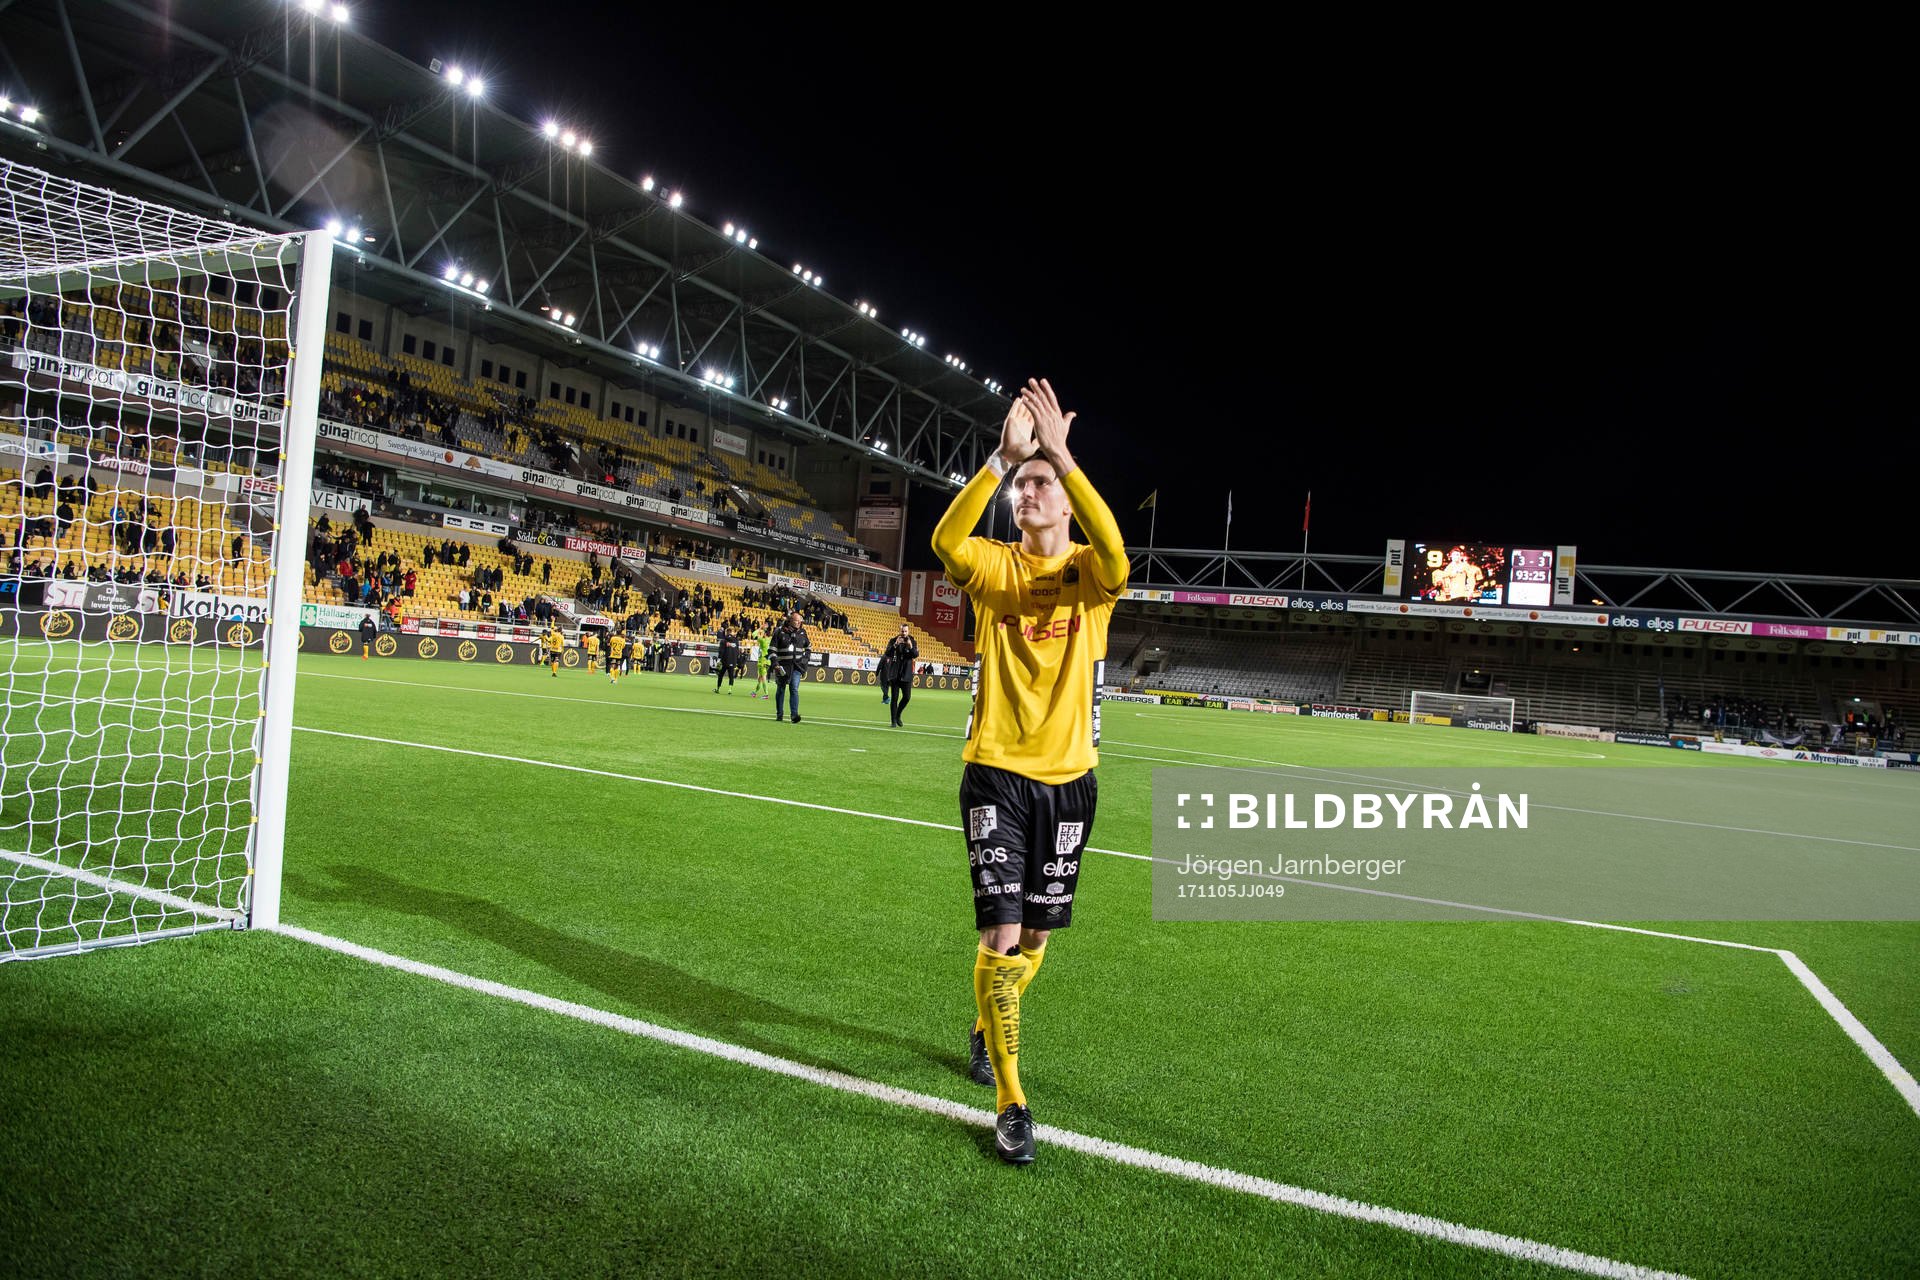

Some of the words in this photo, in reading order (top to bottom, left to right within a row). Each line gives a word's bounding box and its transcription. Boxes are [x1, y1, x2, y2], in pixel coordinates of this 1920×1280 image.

[234, 401, 281, 422] ginatri
[387, 440, 417, 453] Swedbank
[244, 479, 278, 492] SPEE
[309, 491, 361, 511] VENTI
[516, 530, 537, 543] Söder
[537, 531, 548, 545] &
[546, 534, 558, 547] Co.
[567, 537, 588, 551] TEAM
[588, 540, 619, 557] SPORTIA
[622, 548, 645, 558] SPEED
[1389, 548, 1402, 566] put
[1427, 550, 1443, 568] 9
[1518, 556, 1526, 566] 3
[1538, 556, 1545, 567] 3
[1515, 570, 1546, 581] 93:25
[793, 578, 809, 587] SPEED
[814, 583, 838, 595] SERNEKE
[1556, 577, 1570, 595] put
[1187, 593, 1216, 602] Folksam
[1232, 595, 1284, 607] PULSEN
[1291, 598, 1314, 609] ellos
[1320, 599, 1344, 610] ellos
[999, 614, 1081, 642] PULSEN
[1612, 615, 1639, 628] ellos
[1646, 617, 1674, 630] ellos
[1682, 619, 1748, 633] PULSEN
[1769, 624, 1809, 637] Folksam
[1846, 630, 1861, 640] put
[1885, 633, 1900, 643] put
[1311, 708, 1360, 720] brainforest.
[1467, 718, 1511, 731] Simplicity
[1811, 752, 1859, 766] Myresjöhus
[972, 808, 990, 819] EFF
[972, 817, 994, 828] EKT
[1061, 825, 1079, 834] EFF
[1060, 833, 1080, 843] EKT
[969, 843, 1008, 867] ellos
[1043, 857, 1078, 877] ellos
